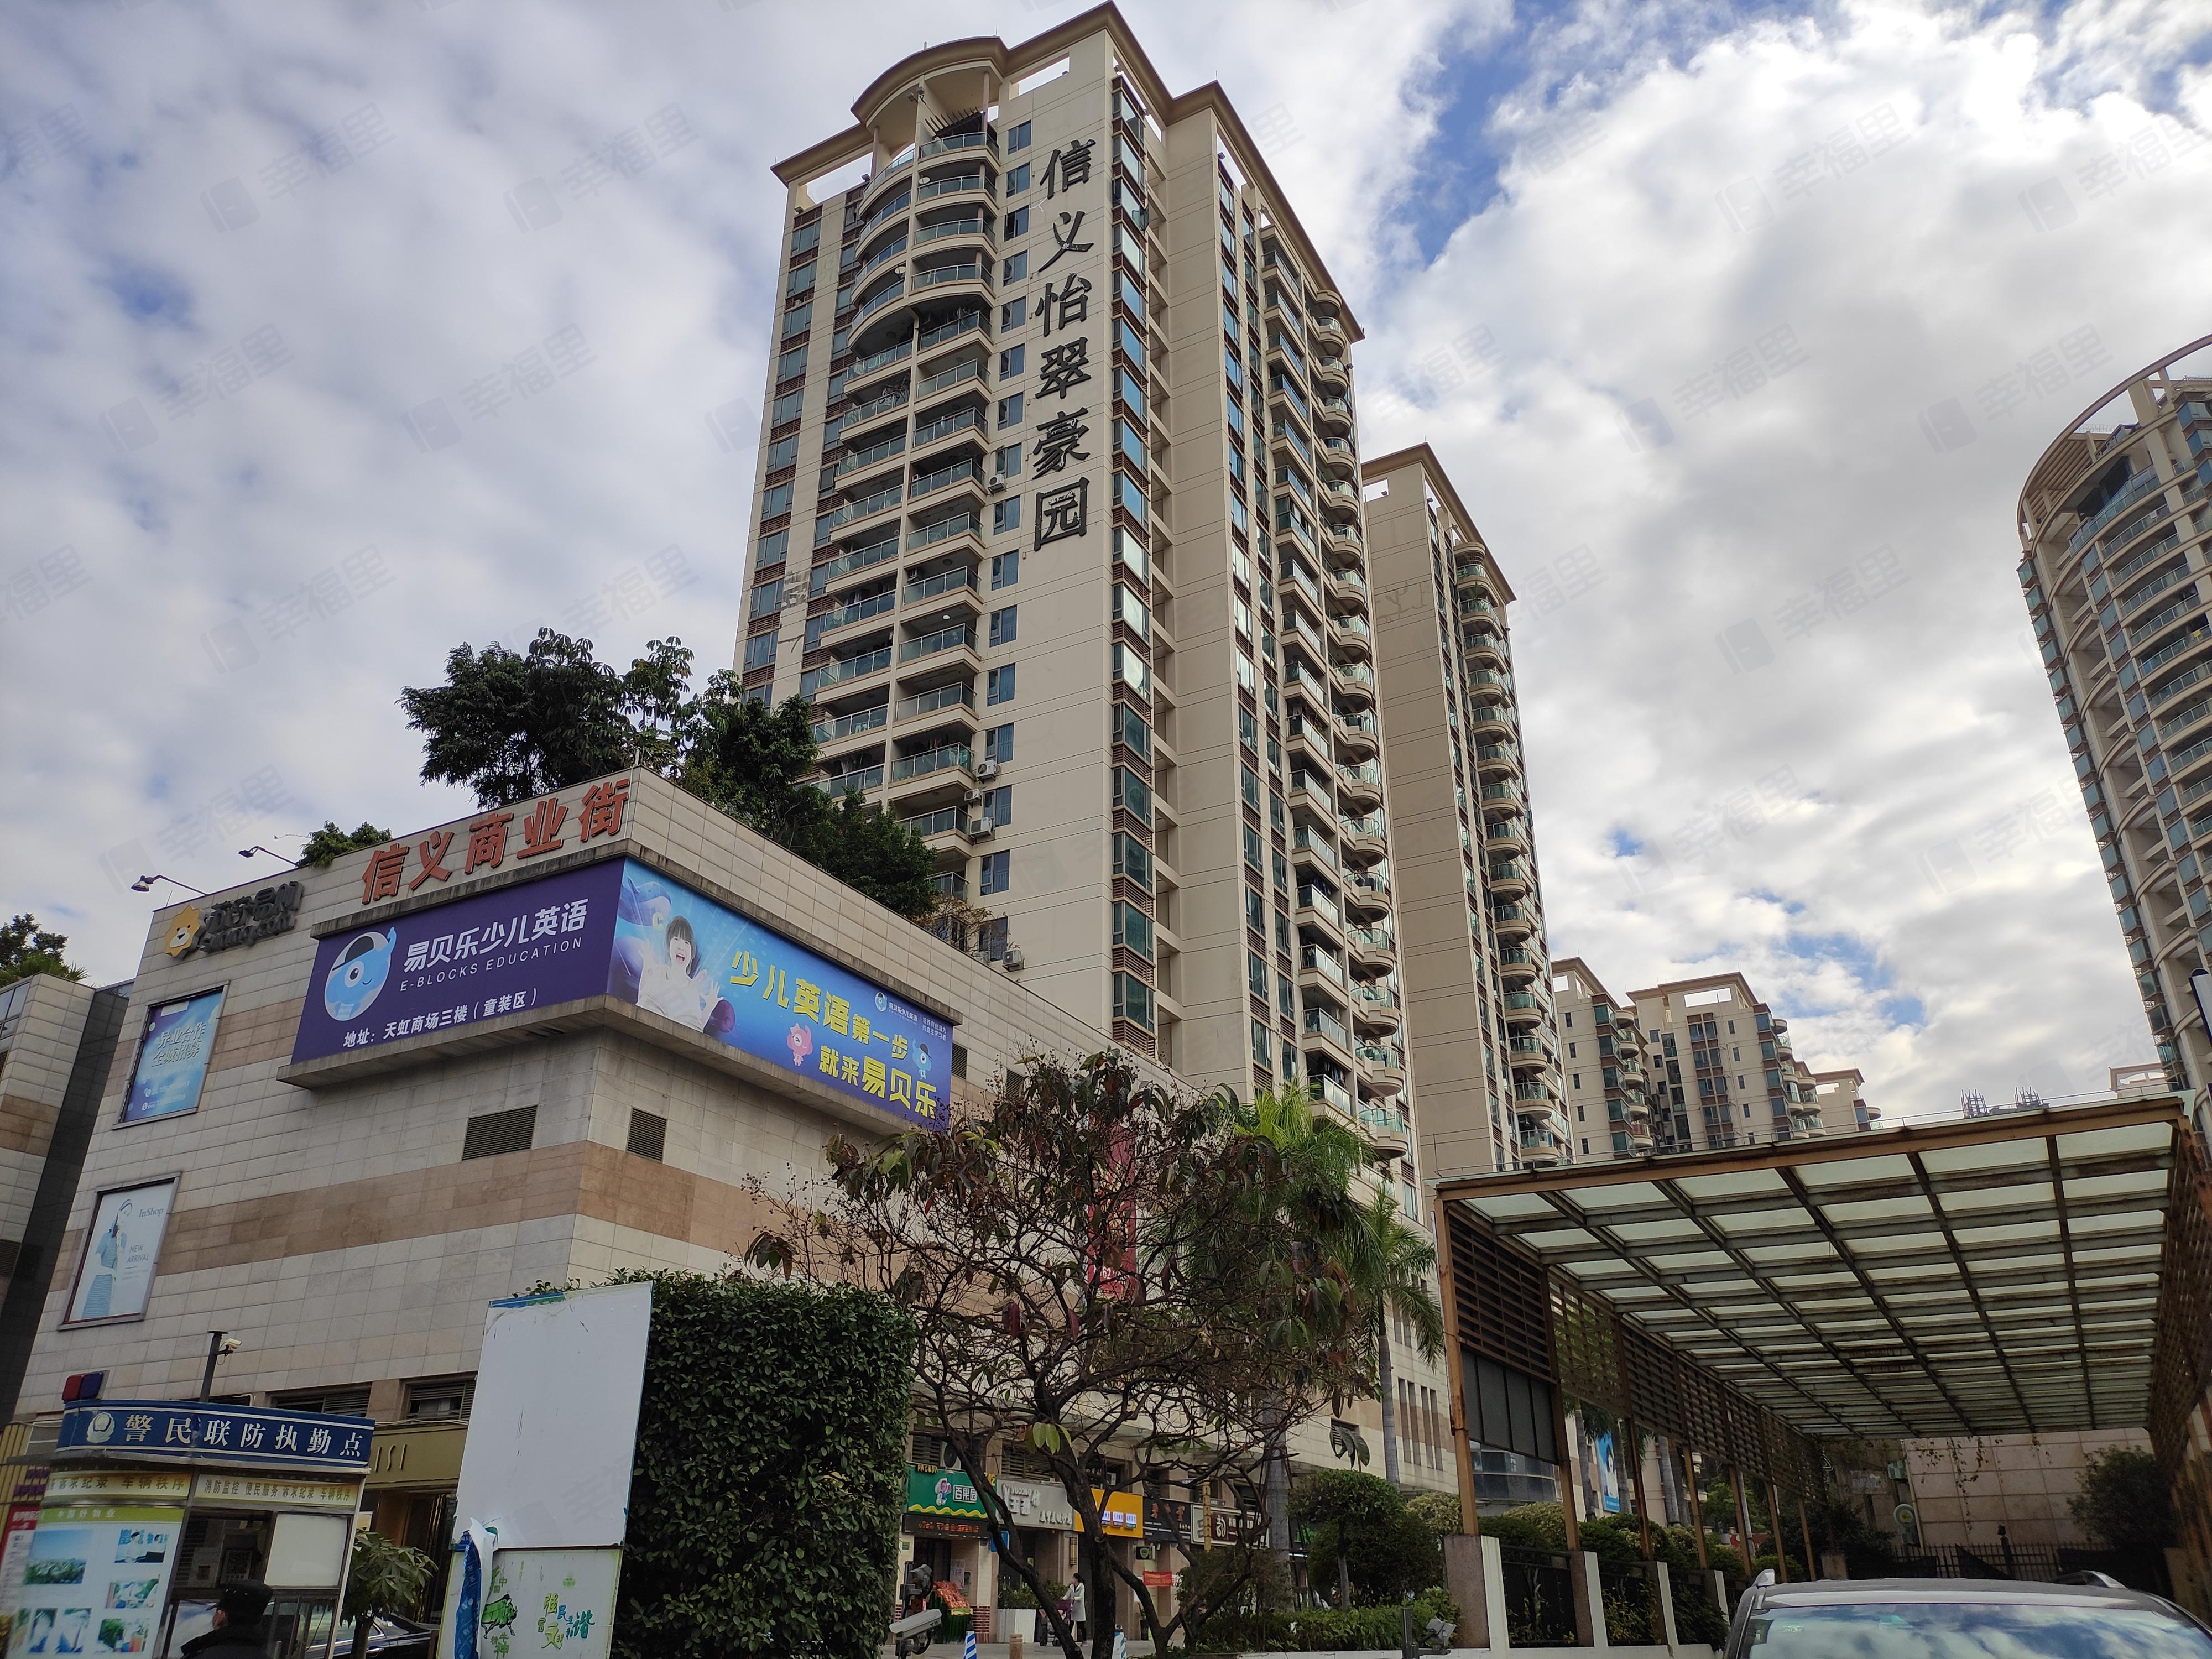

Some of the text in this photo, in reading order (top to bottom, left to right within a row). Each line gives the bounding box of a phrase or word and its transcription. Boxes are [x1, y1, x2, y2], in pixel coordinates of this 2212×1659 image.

[1032, 139, 1096, 552] 信义怡翠豪园
[361, 778, 629, 904] 信义商业街
[403, 898, 588, 973] 易贝乐少儿英语
[400, 937, 582, 992] E-BLOCKS EDUCATION
[729, 949, 909, 1060] 少儿英语第一步
[158, 1021, 207, 1050] 异业合作
[819, 1044, 937, 1118] 就来易贝乐
[138, 1207, 164, 1218] InShop
[126, 1254, 150, 1264] ARRIVAL
[129, 1244, 144, 1253] NEW
[124, 1414, 362, 1458] 警民联防执勤点
[122, 1477, 186, 1490] 车辆秩序
[204, 1480, 239, 1495] 消防监控
[244, 1482, 278, 1497] 便民服务
[320, 1487, 351, 1501] 车辆秩序
